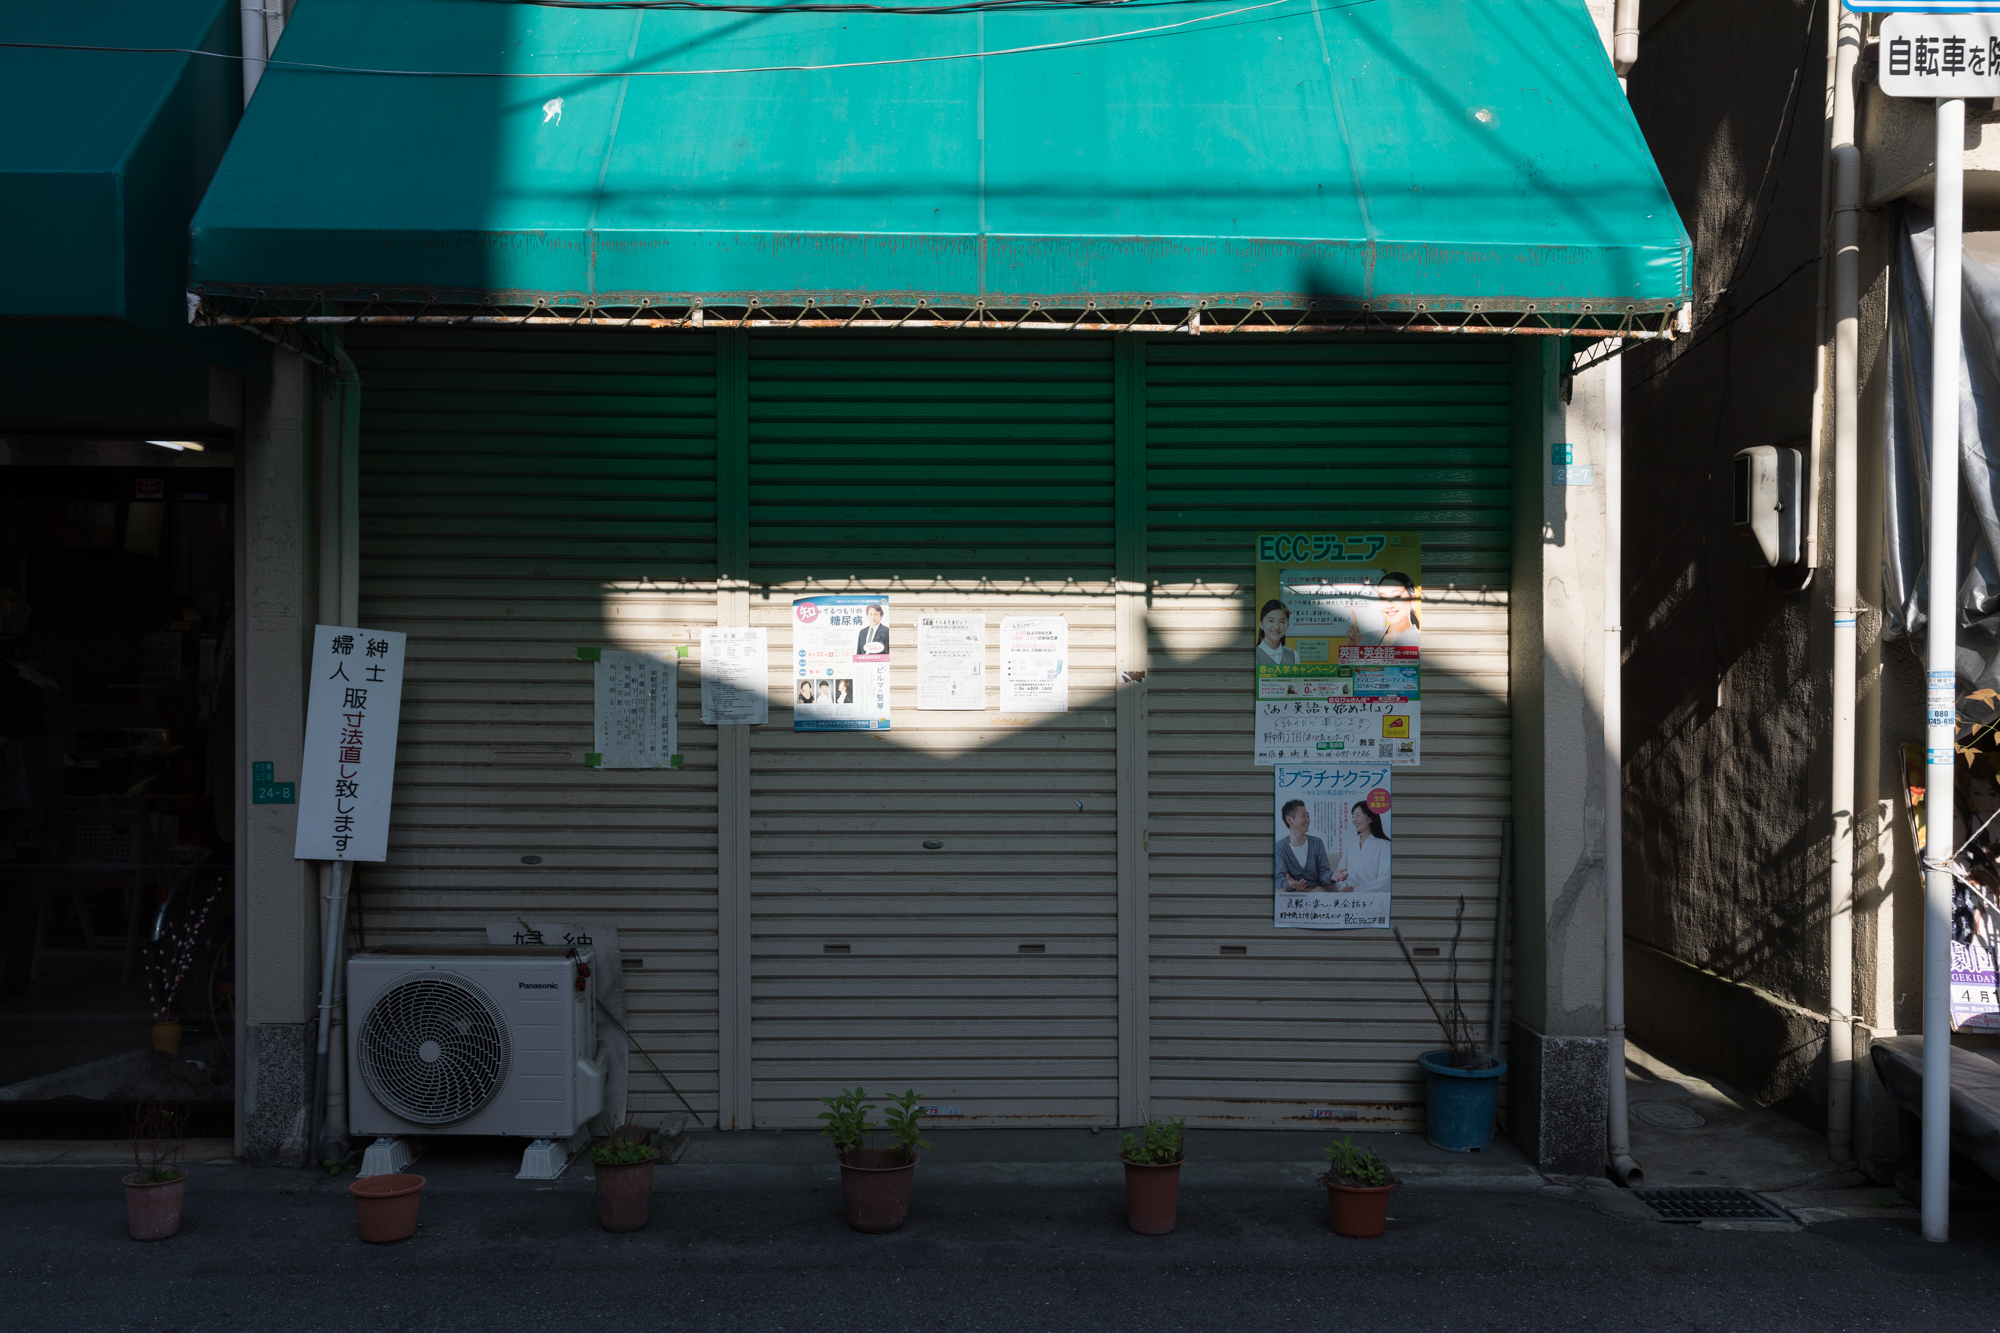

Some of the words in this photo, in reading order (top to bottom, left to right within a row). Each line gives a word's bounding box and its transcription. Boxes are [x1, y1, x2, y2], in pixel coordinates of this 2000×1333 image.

[1557, 469, 1590, 480] 24-7
[1258, 534, 1386, 562] ECCジュニア
[830, 616, 863, 626] 糖尿病
[330, 634, 354, 682] 婦人
[1340, 647, 1395, 658] 英語・英会話
[366, 638, 388, 682] 紳士
[1259, 666, 1337, 674] 春の入学キャンペーン
[1359, 738, 1376, 747] 教室
[332, 687, 368, 852] 服寸法直し致します
[1285, 768, 1388, 788] プラチナクラブ
[259, 788, 290, 798] 24-8
[1952, 974, 1997, 983] GEKIDAN
